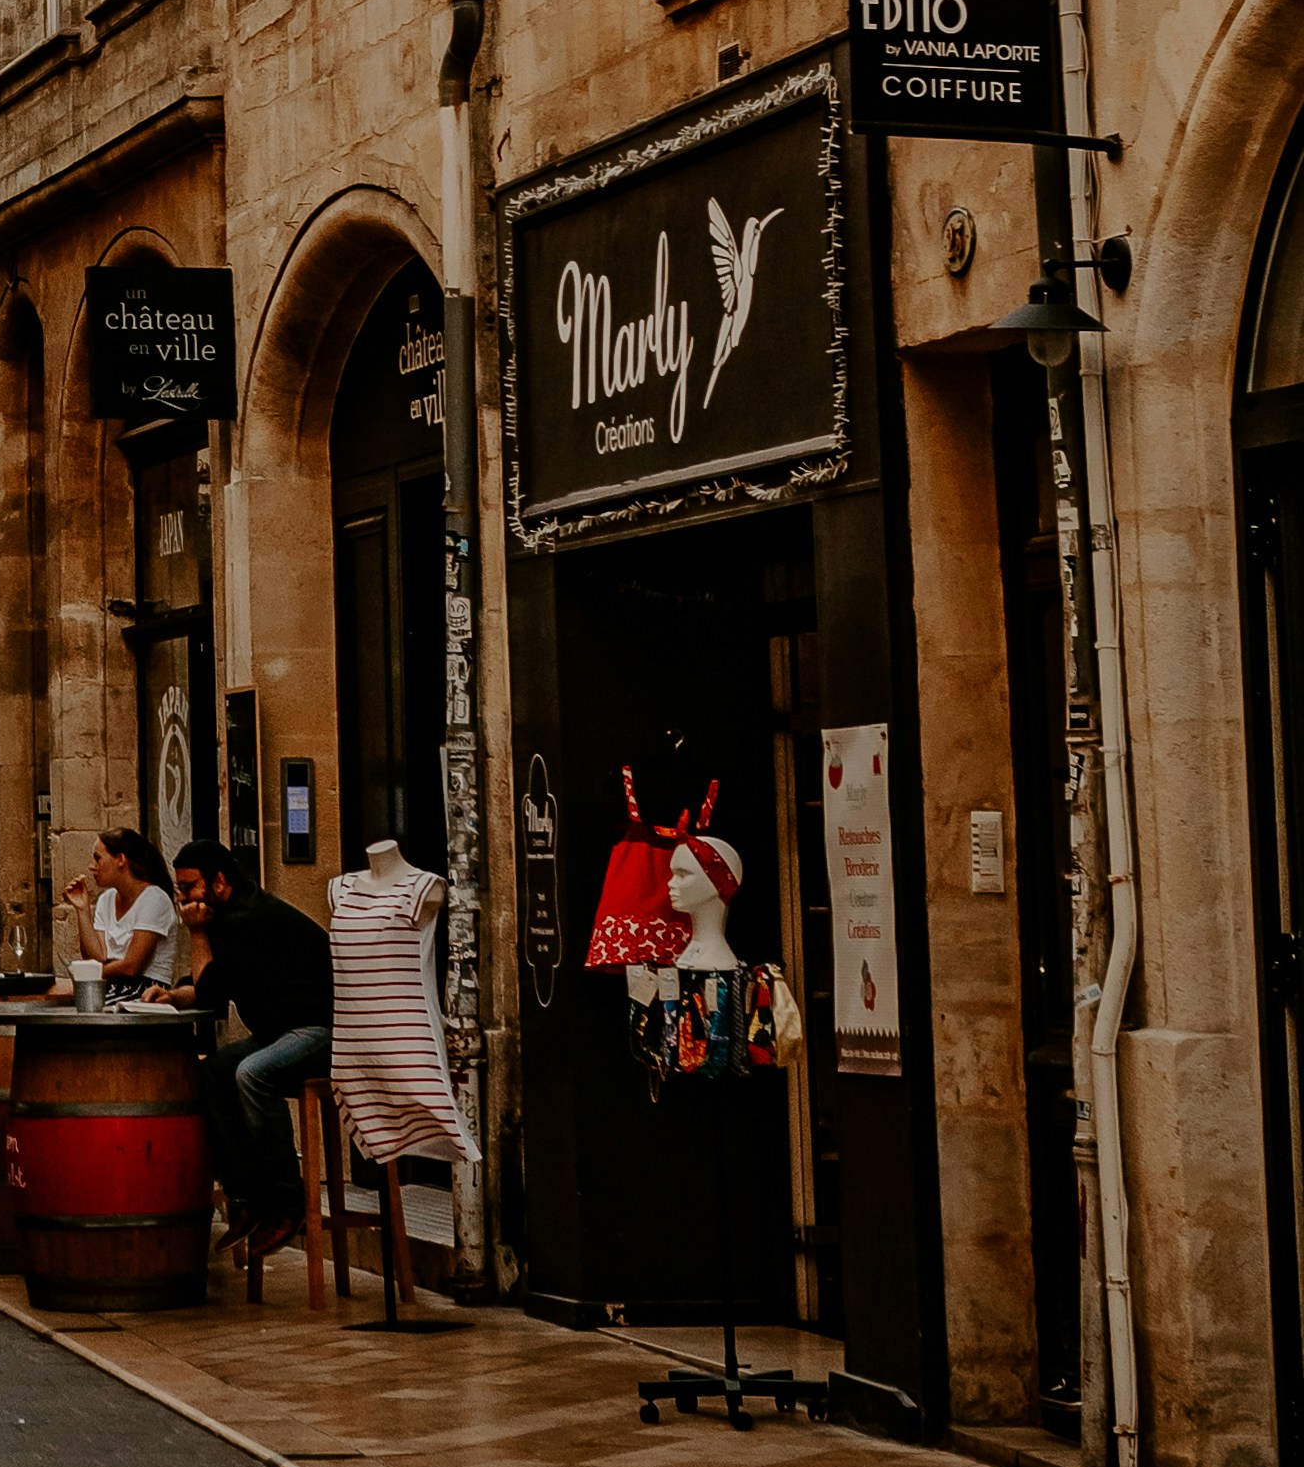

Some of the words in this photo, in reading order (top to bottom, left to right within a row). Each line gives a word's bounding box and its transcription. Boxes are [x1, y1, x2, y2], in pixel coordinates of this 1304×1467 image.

[884, 43, 902, 57] by
[903, 39, 960, 58] VANIA
[963, 42, 1041, 62] LAPORTE
[881, 75, 1022, 103] COIFFURE
[125, 288, 147, 300] un
[105, 302, 215, 330] château
[129, 343, 150, 355] en
[155, 333, 216, 361] ville
[399, 322, 445, 375] châtea
[557, 230, 694, 444] Marly
[121, 380, 137, 396] by
[422, 368, 445, 427] vill
[595, 414, 655, 455] Créations
[159, 508, 184, 558] JAPAN
[838, 826, 882, 846] Retouches
